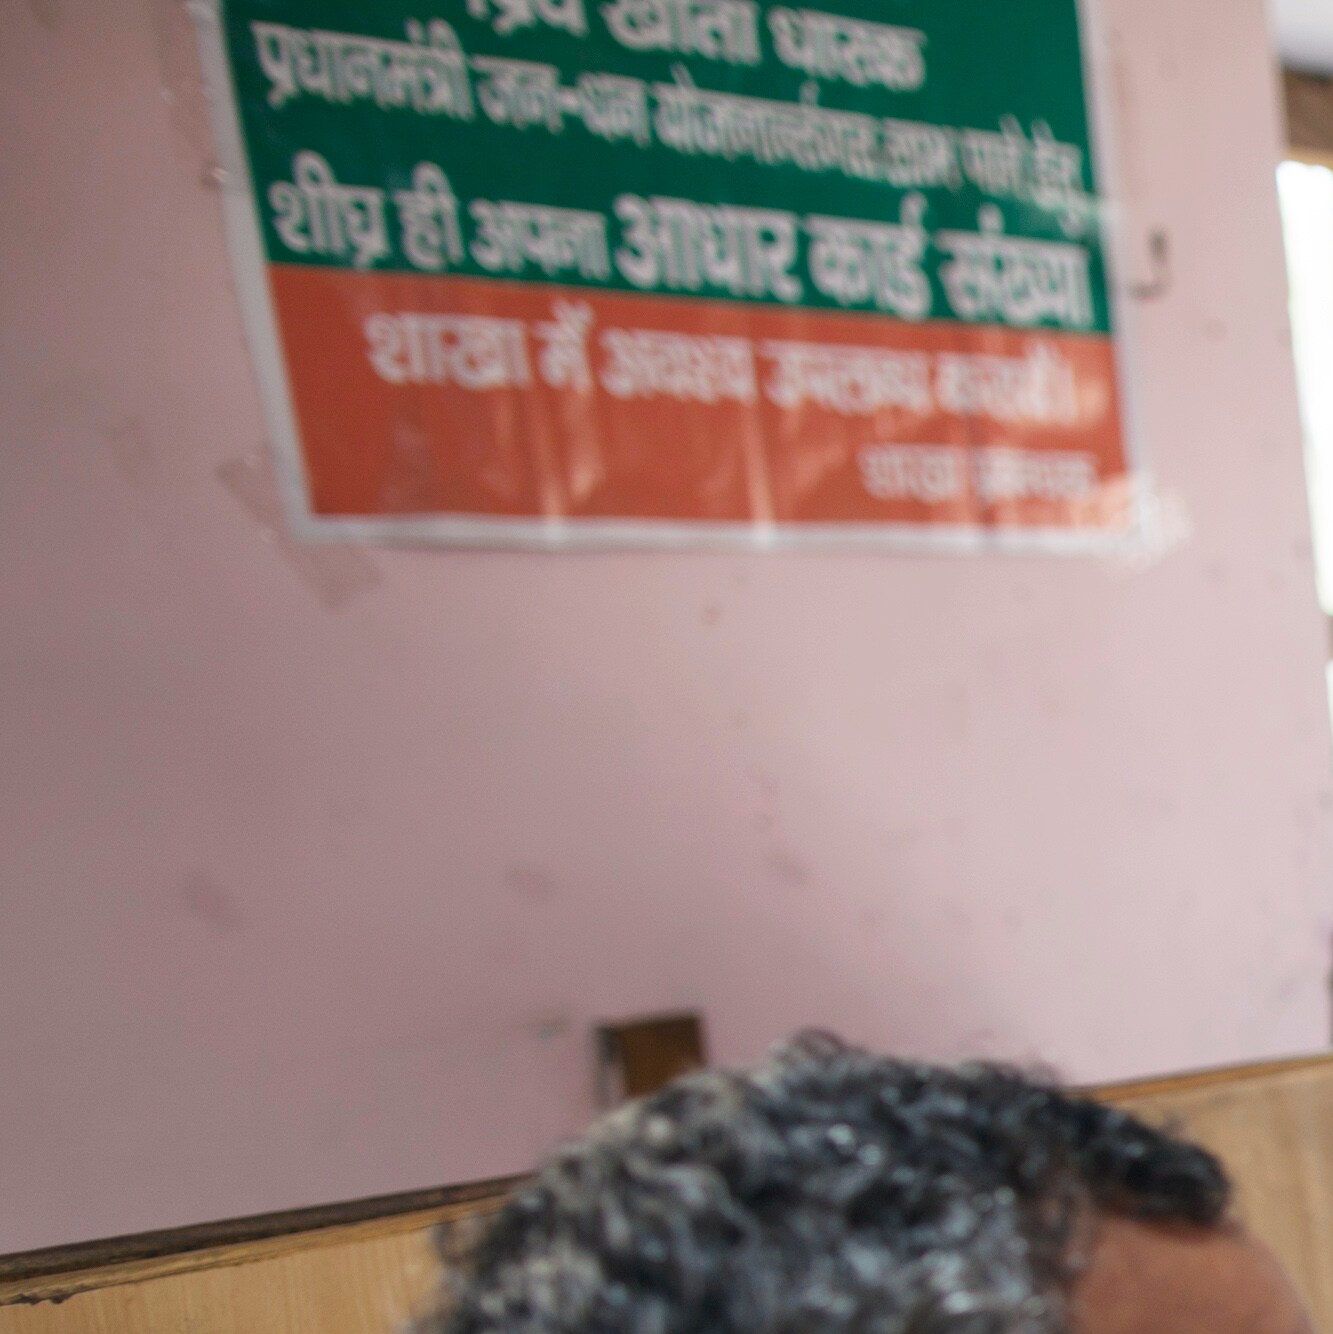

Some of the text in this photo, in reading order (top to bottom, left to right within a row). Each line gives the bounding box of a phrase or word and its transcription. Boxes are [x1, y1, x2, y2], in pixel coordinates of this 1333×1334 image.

[768, 4, 926, 92] धारक
[268, 148, 1094, 330] शीघ्र ही अपना आधार कार्ड संख्या
[362, 310, 530, 390] शाखा
[535, 300, 598, 396] में
